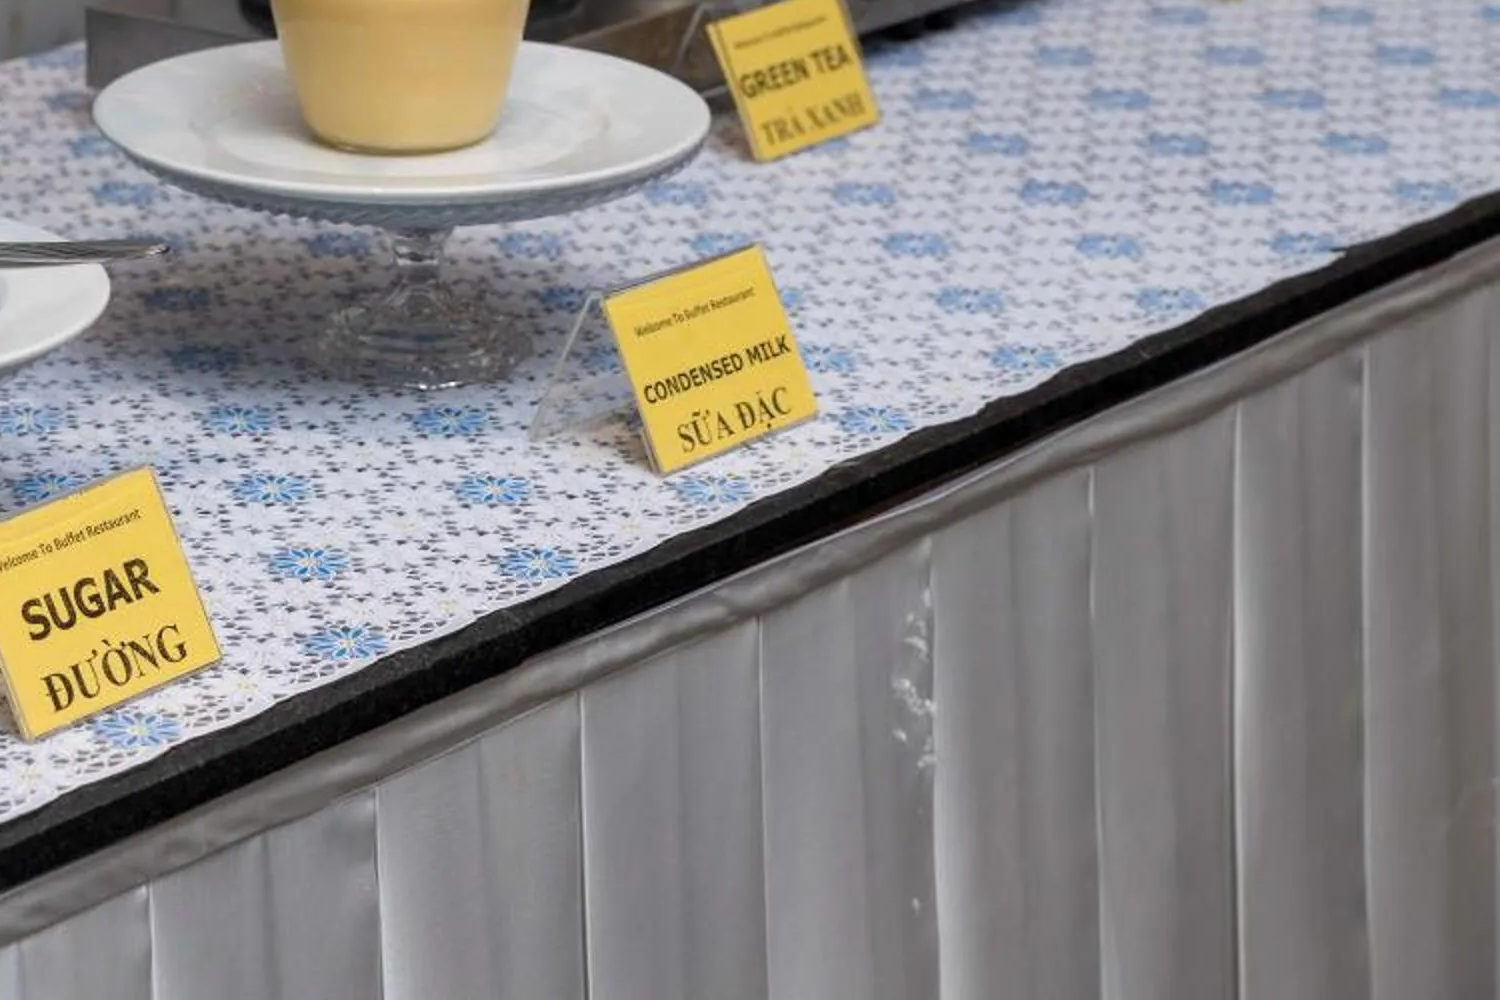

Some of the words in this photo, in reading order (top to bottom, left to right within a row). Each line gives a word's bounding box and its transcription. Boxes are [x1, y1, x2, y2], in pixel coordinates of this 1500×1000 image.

[739, 58, 810, 99] GREEN
[809, 44, 852, 74] TEA
[643, 353, 744, 405] CONDENSED
[744, 334, 791, 366] MILK
[676, 409, 736, 453] SỮA
[38, 542, 53, 556] To
[53, 530, 87, 551] Buffet
[85, 509, 141, 538] Restaurant
[20, 557, 160, 641] SUGAR
[40, 624, 187, 713] ĐƯỜNG
